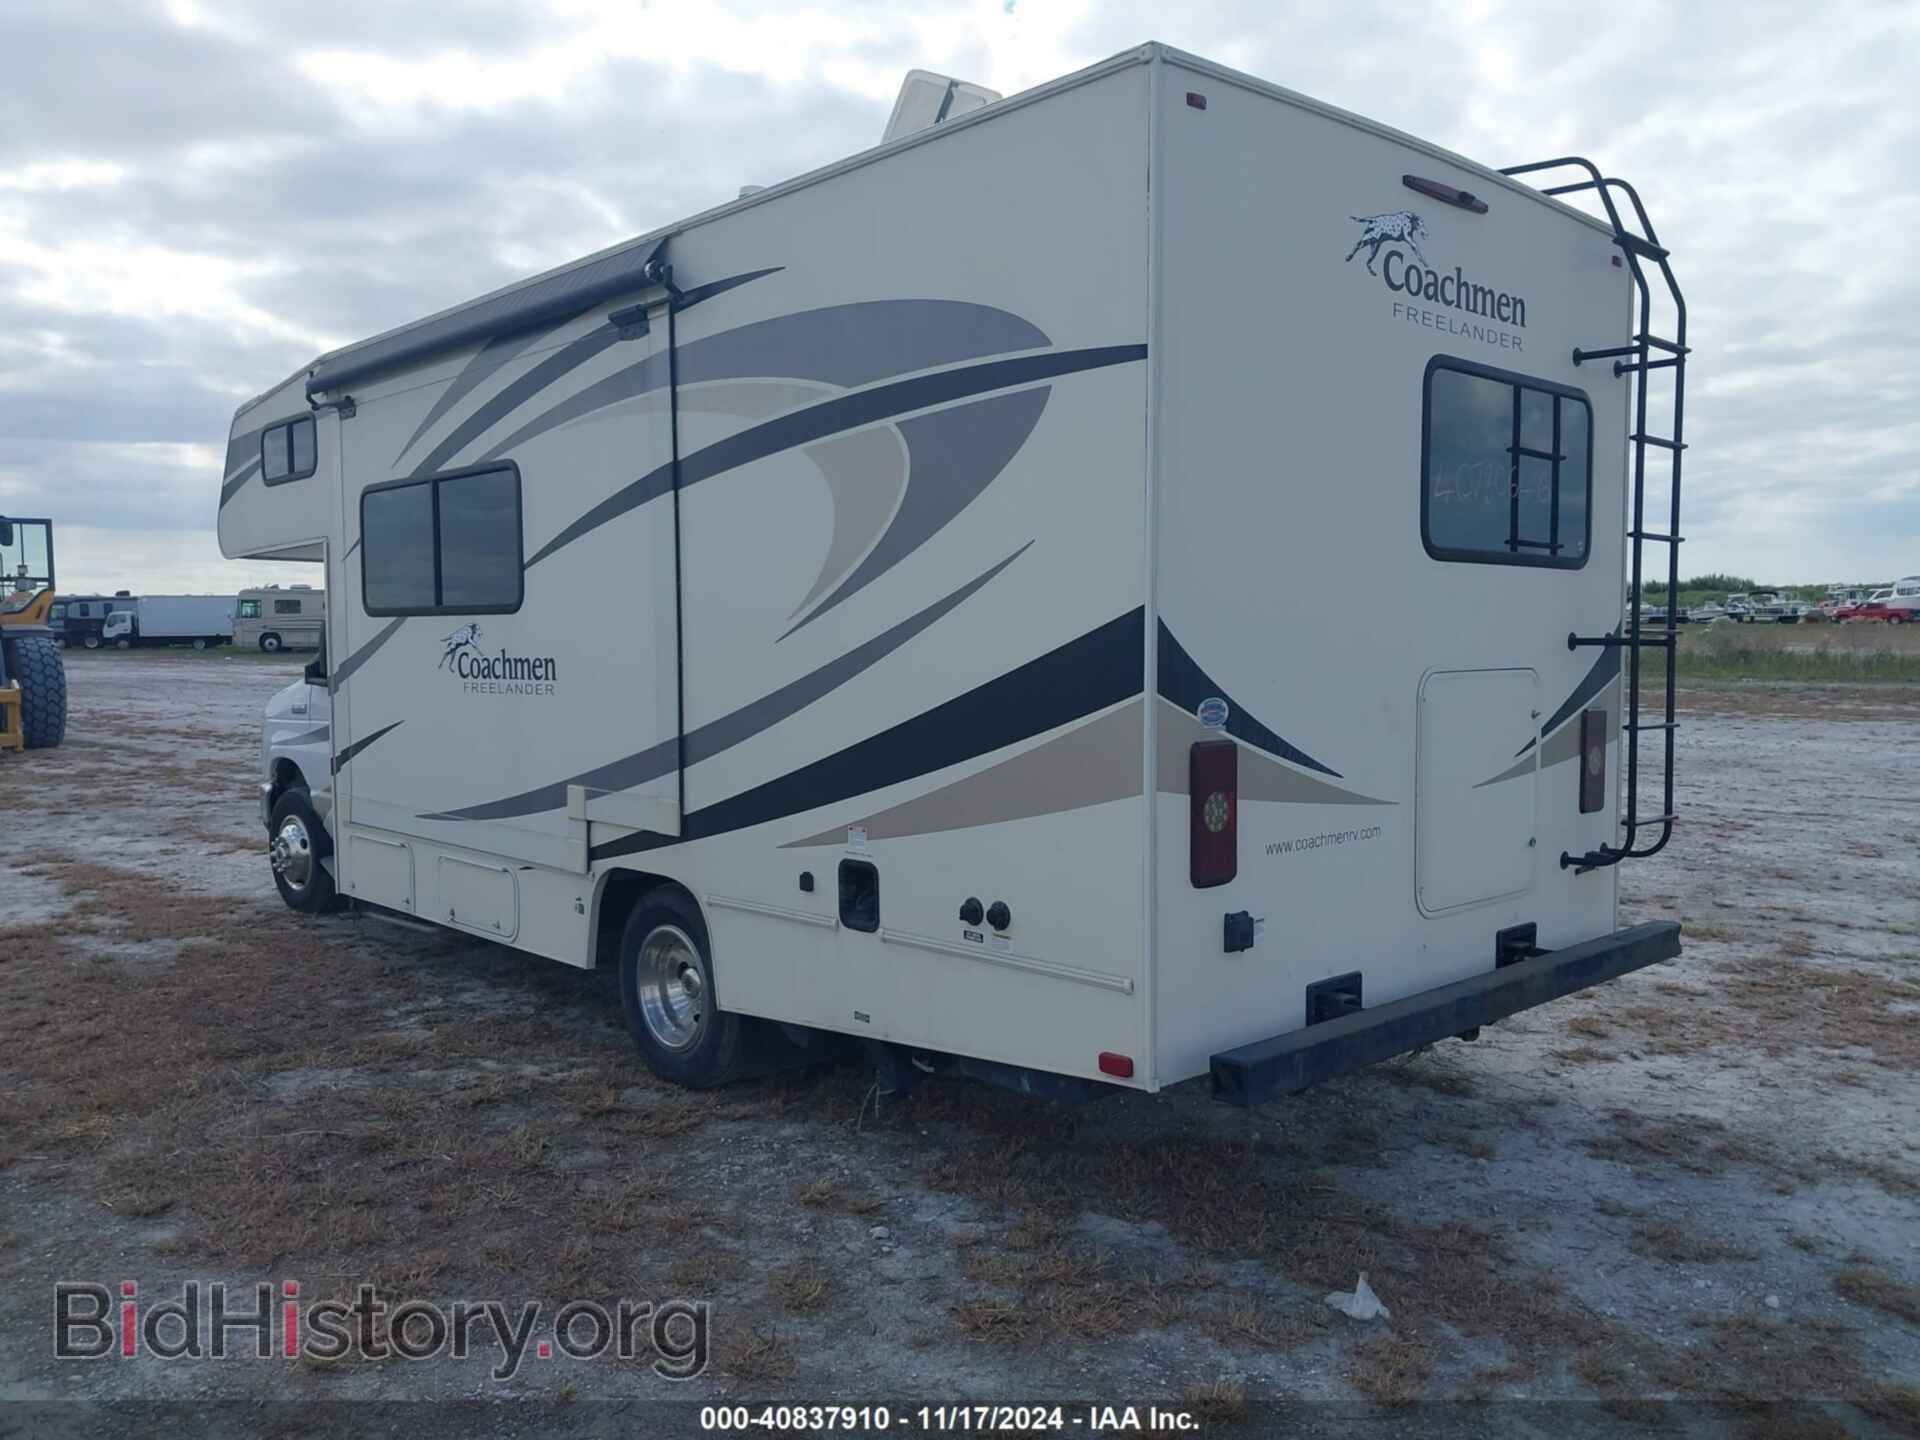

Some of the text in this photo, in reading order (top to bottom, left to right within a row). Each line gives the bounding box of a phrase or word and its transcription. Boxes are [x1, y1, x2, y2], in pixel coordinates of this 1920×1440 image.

[1383, 250, 1527, 328] Coachmen
[1392, 302, 1523, 351] FREELANDER
[457, 648, 557, 681] Coachmen
[463, 682, 555, 696] FREELANDER
[1264, 825, 1382, 856] www.coachmenrv.com
